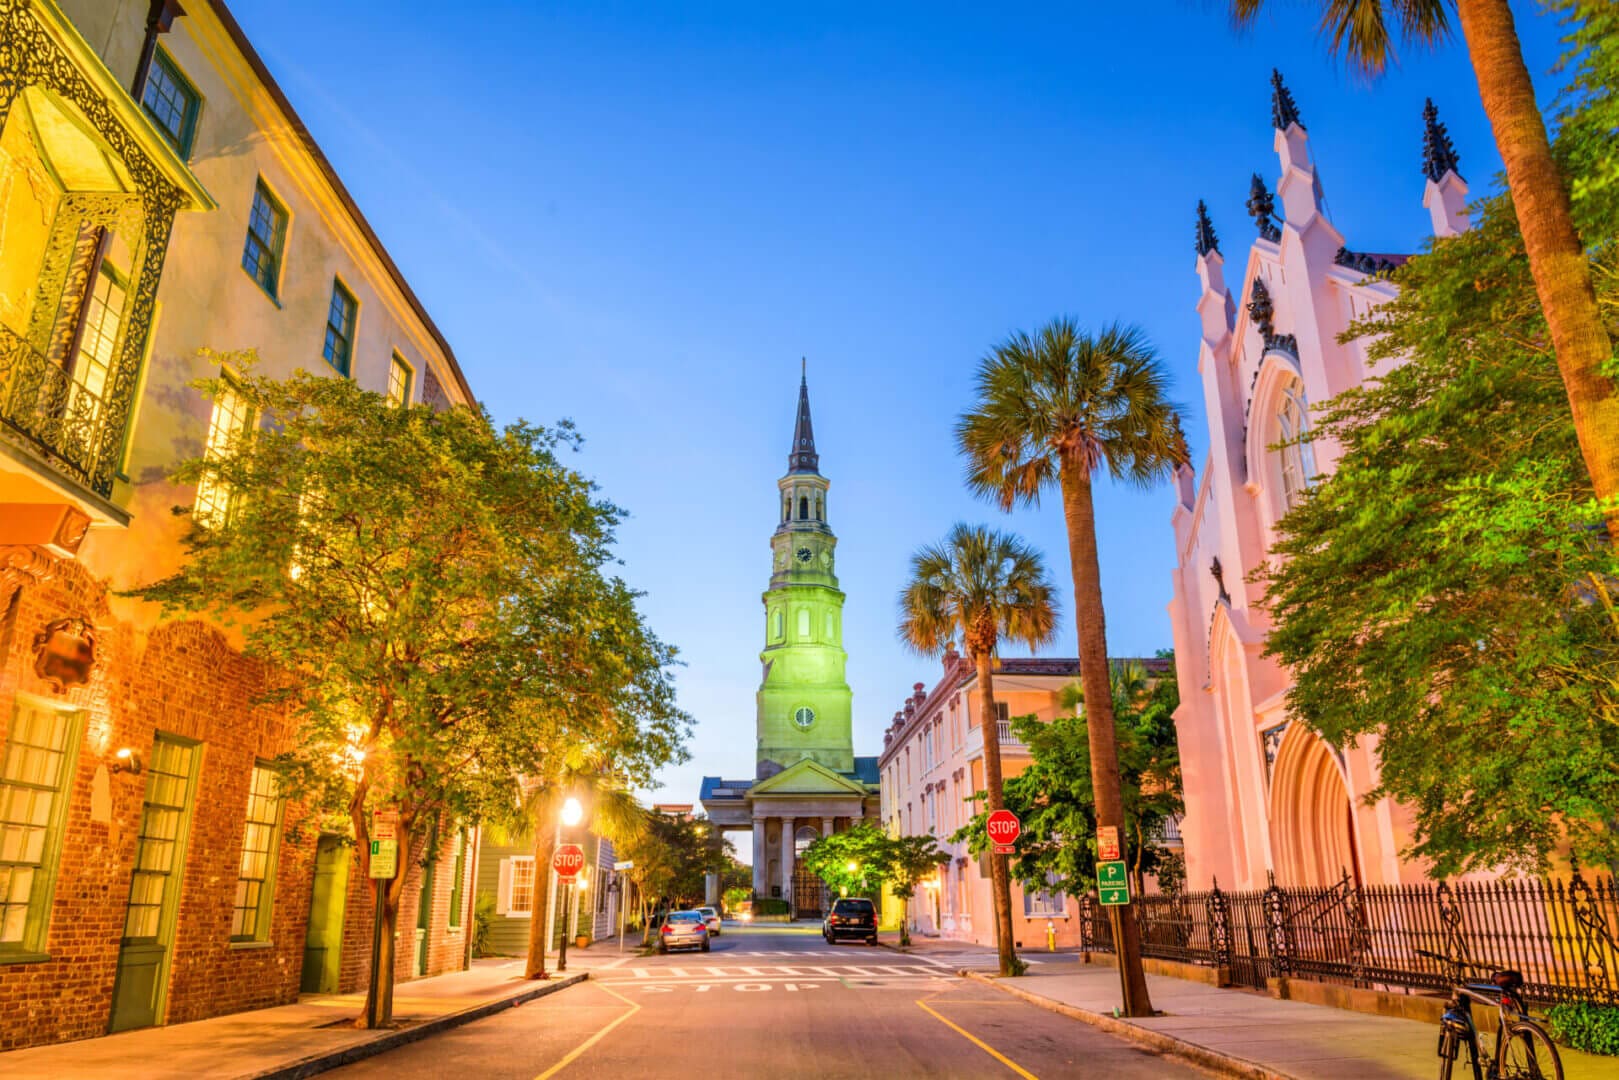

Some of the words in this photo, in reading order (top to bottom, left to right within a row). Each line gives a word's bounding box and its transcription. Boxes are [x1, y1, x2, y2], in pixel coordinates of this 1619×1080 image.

[990, 821, 1017, 834] STOP
[555, 854, 582, 867] STOP
[1107, 866, 1117, 878] P
[641, 983, 820, 992] STOP
